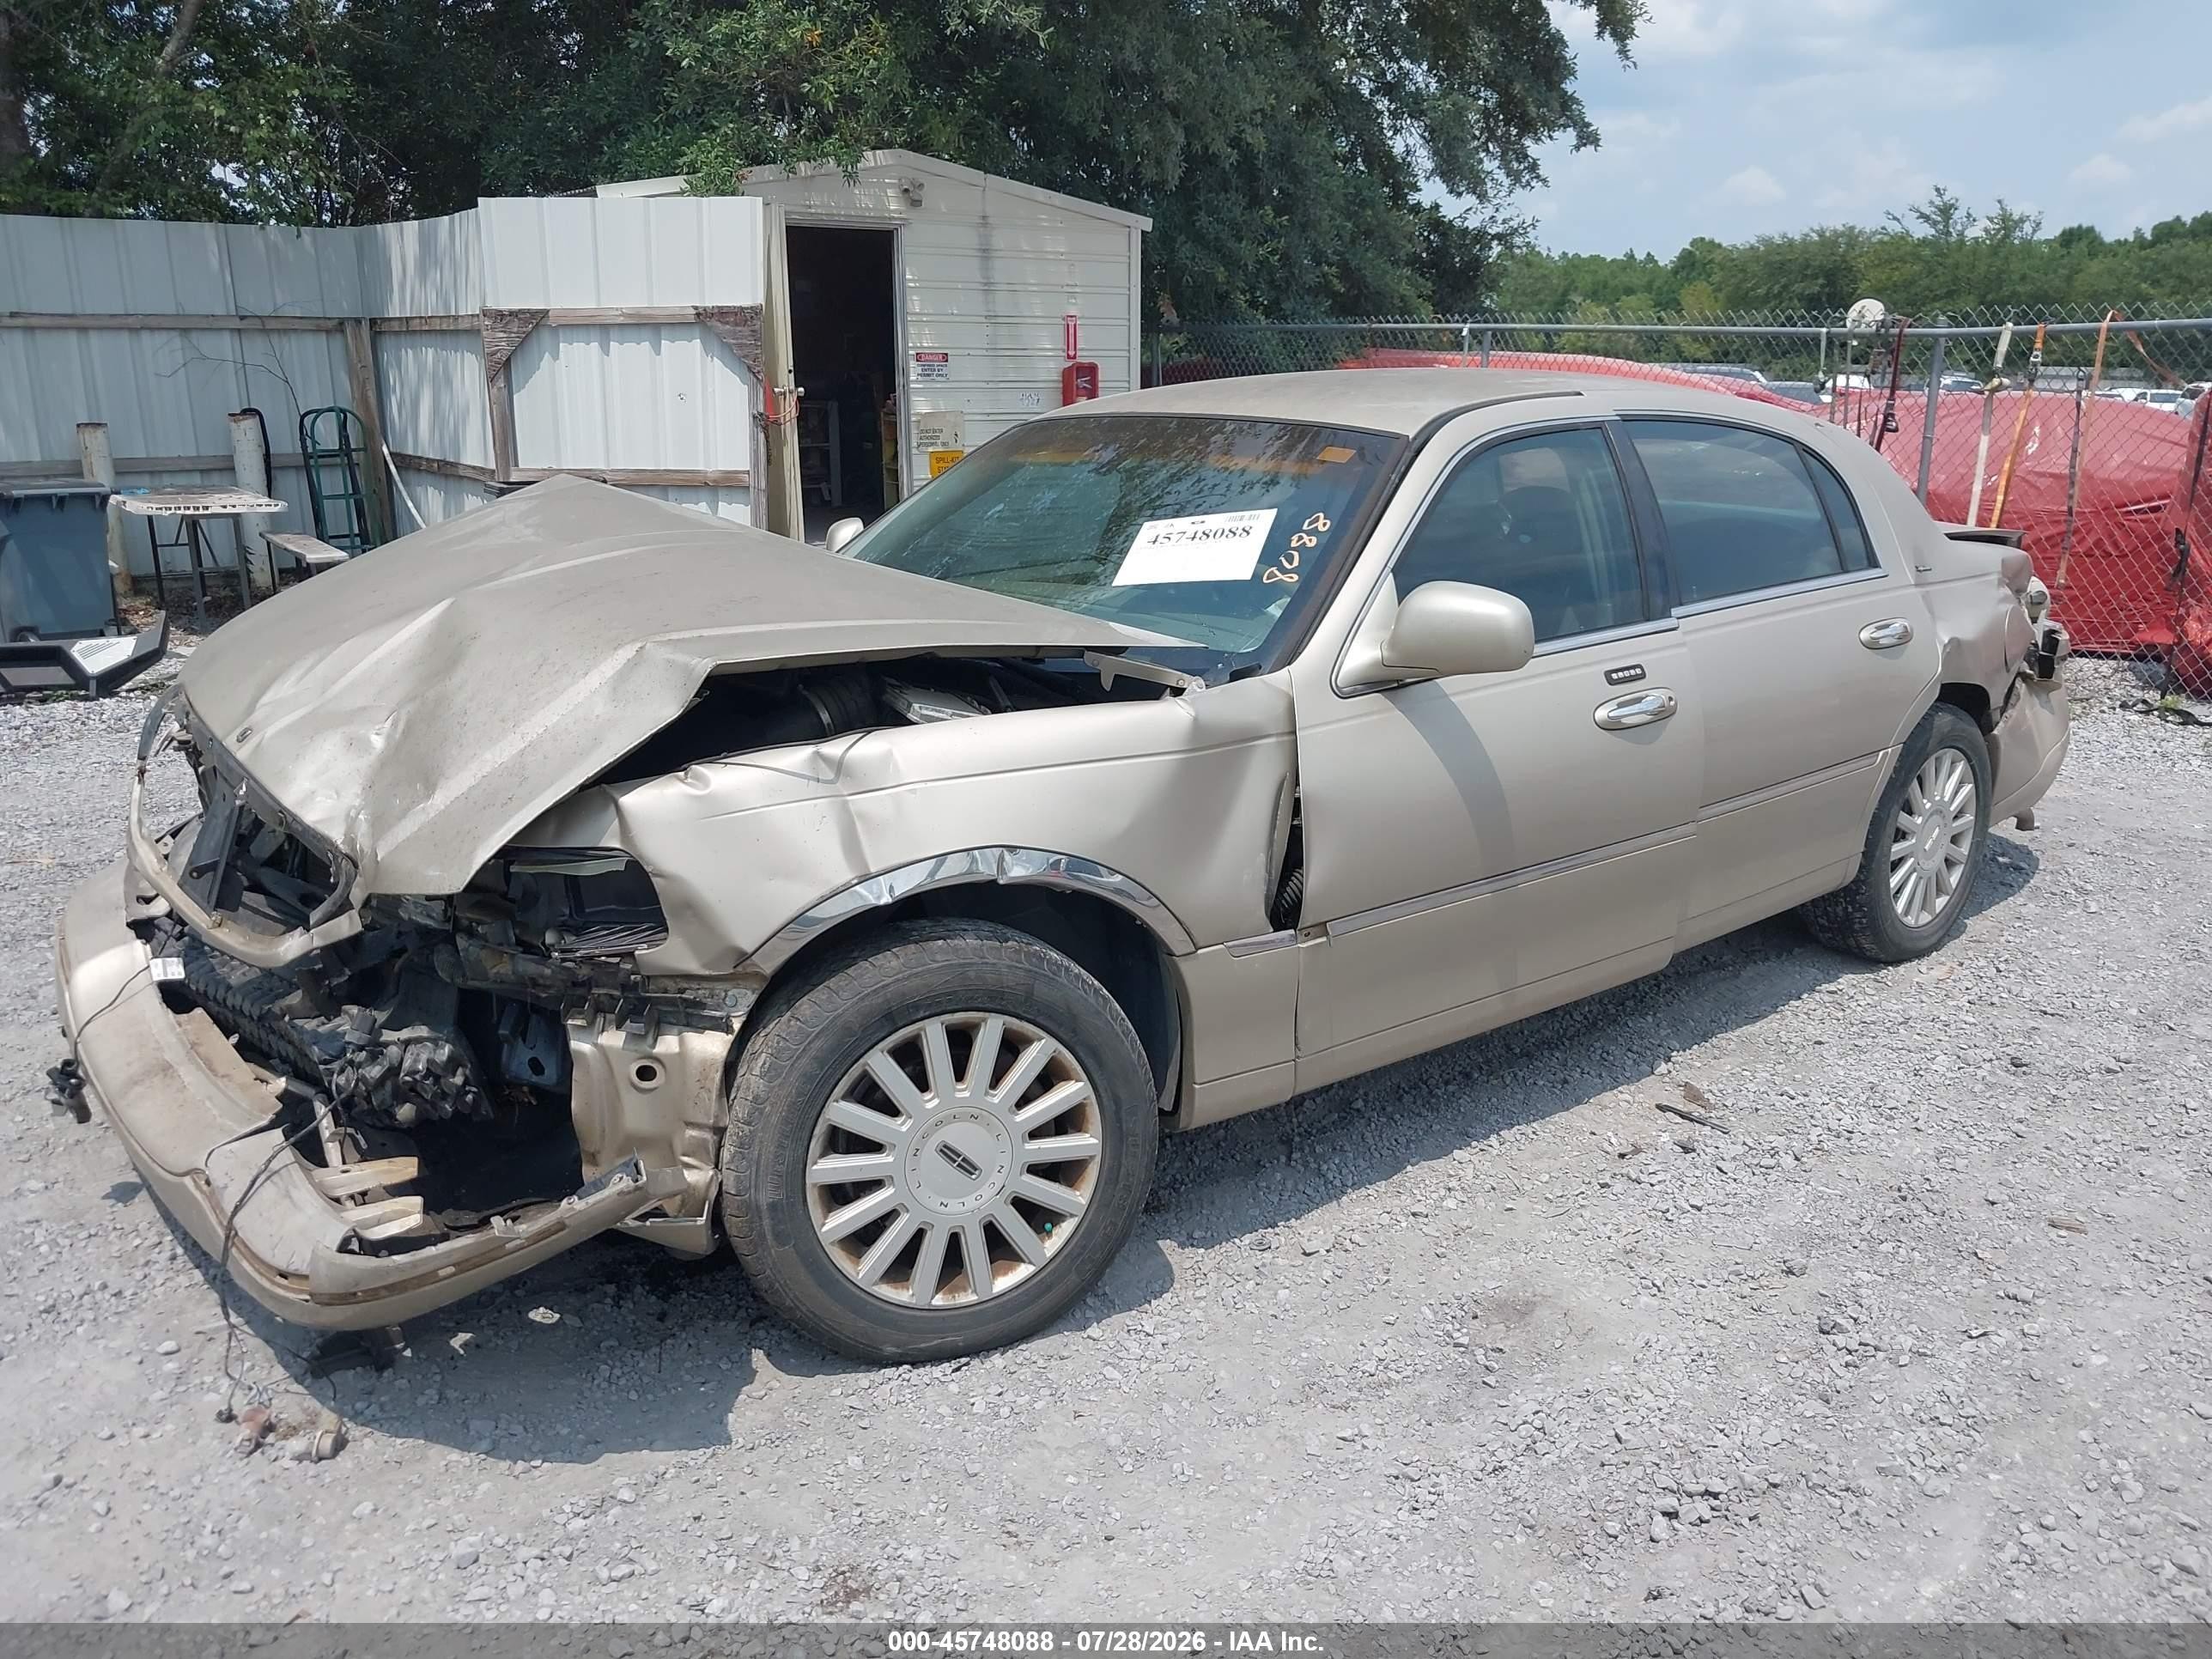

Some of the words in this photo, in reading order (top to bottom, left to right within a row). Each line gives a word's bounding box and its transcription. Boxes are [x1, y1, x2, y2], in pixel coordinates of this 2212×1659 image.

[1147, 525, 1253, 545] 45748088
[1262, 512, 1331, 583] 8088
[911, 1114, 979, 1188] LINCOLN
